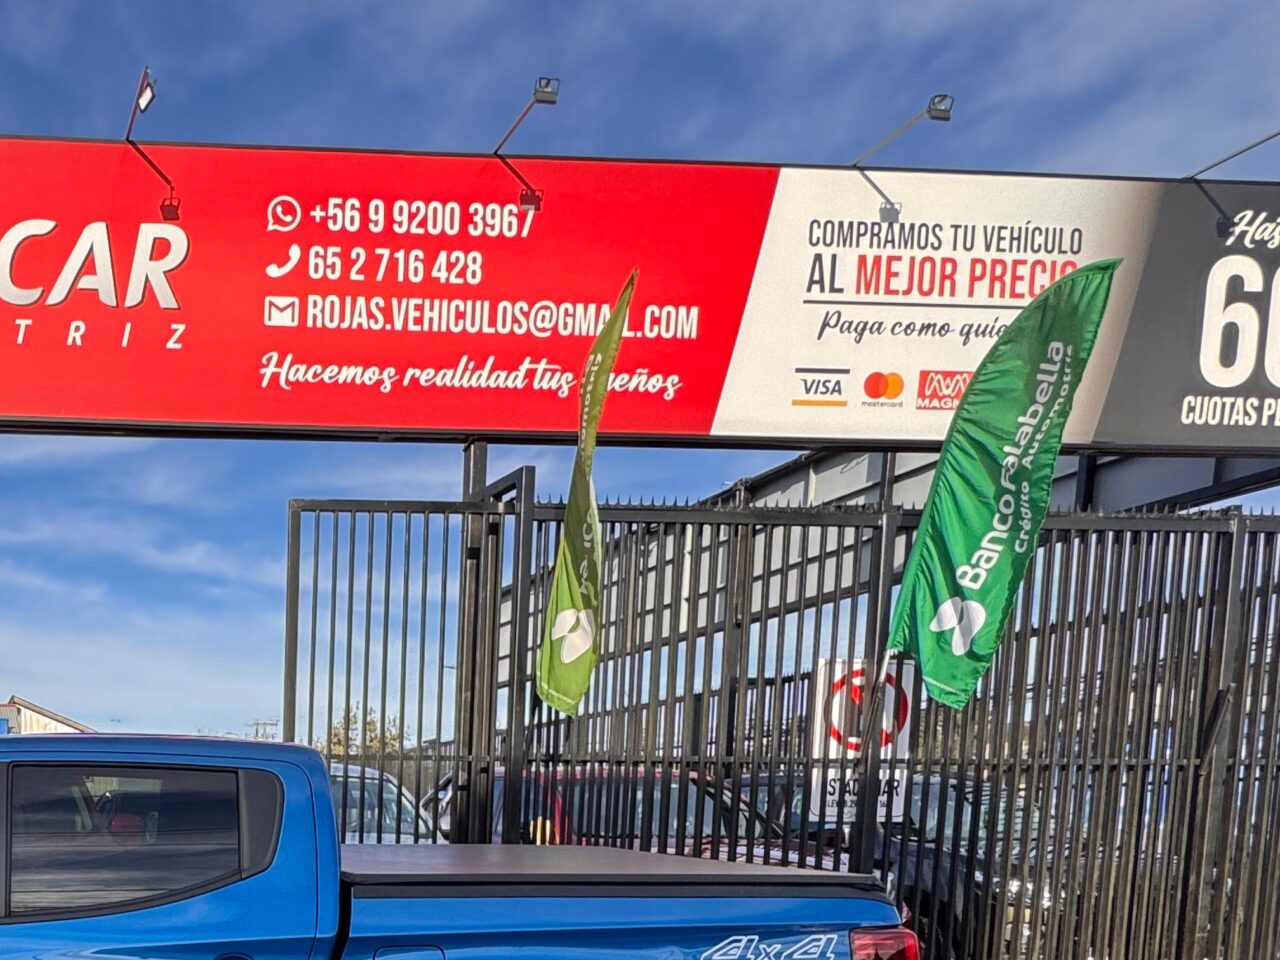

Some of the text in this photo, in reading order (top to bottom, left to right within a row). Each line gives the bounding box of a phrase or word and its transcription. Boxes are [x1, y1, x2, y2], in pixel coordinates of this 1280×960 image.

[310, 198, 536, 238] +56 9 9200 3967
[808, 218, 1083, 255] COMPRAMOS TU VEHÍCULO
[308, 245, 483, 285] 65 2 716 428
[806, 253, 844, 294] AL
[855, 255, 958, 297] MEJOR
[307, 295, 699, 339] ROJAS.VEHICULOS@GMAL.COM
[817, 310, 886, 345] Paga
[891, 319, 954, 337] como
[260, 352, 400, 393] Hacemos
[402, 354, 531, 389] realidad
[519, 357, 578, 398] tus
[607, 368, 684, 400] eños
[800, 378, 842, 396] VISA
[861, 400, 903, 408] mastercard
[1180, 395, 1259, 426] CUOTAS
